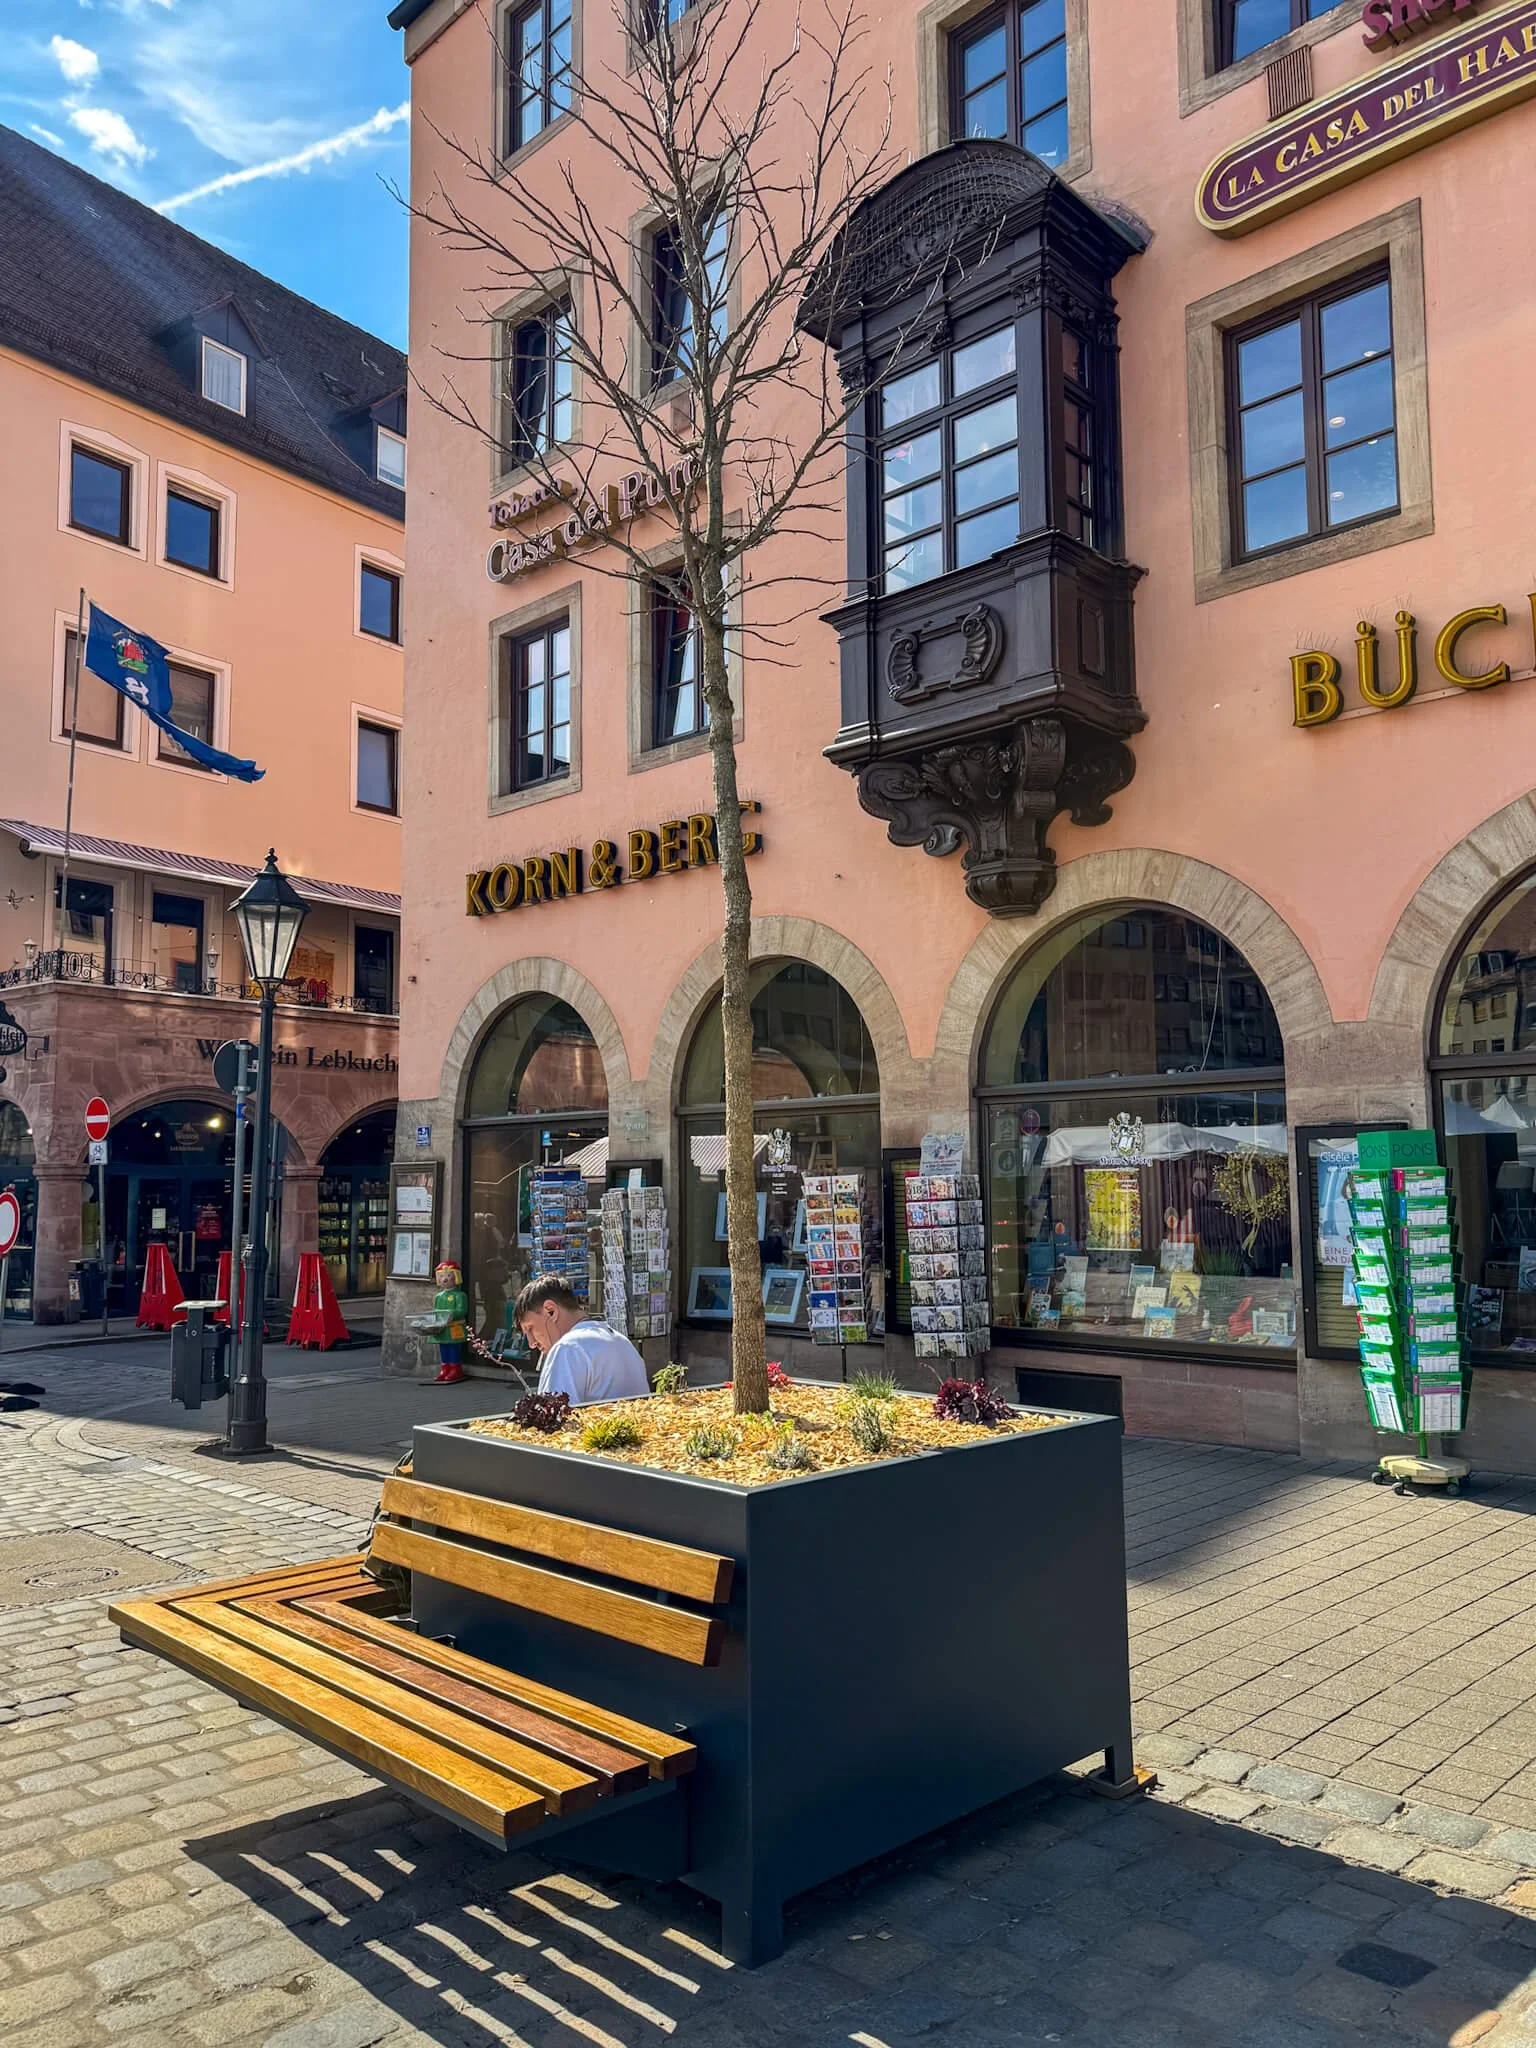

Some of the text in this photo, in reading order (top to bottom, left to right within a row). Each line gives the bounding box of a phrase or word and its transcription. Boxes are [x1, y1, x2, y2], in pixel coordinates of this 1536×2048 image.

[1228, 166, 1265, 200] LA
[1275, 109, 1370, 173] CASA
[1382, 77, 1445, 121] DEL
[486, 526, 560, 583] Casa
[1289, 595, 1536, 728] BÜC
[466, 847, 583, 916] KORN
[589, 839, 621, 888] &
[306, 1046, 399, 1073] Lebkuch
[1320, 1151, 1350, 1163] Gisèle
[1361, 1143, 1388, 1160] PONS
[1392, 1142, 1433, 1158] PONS
[1324, 1246, 1348, 1255] EINE
